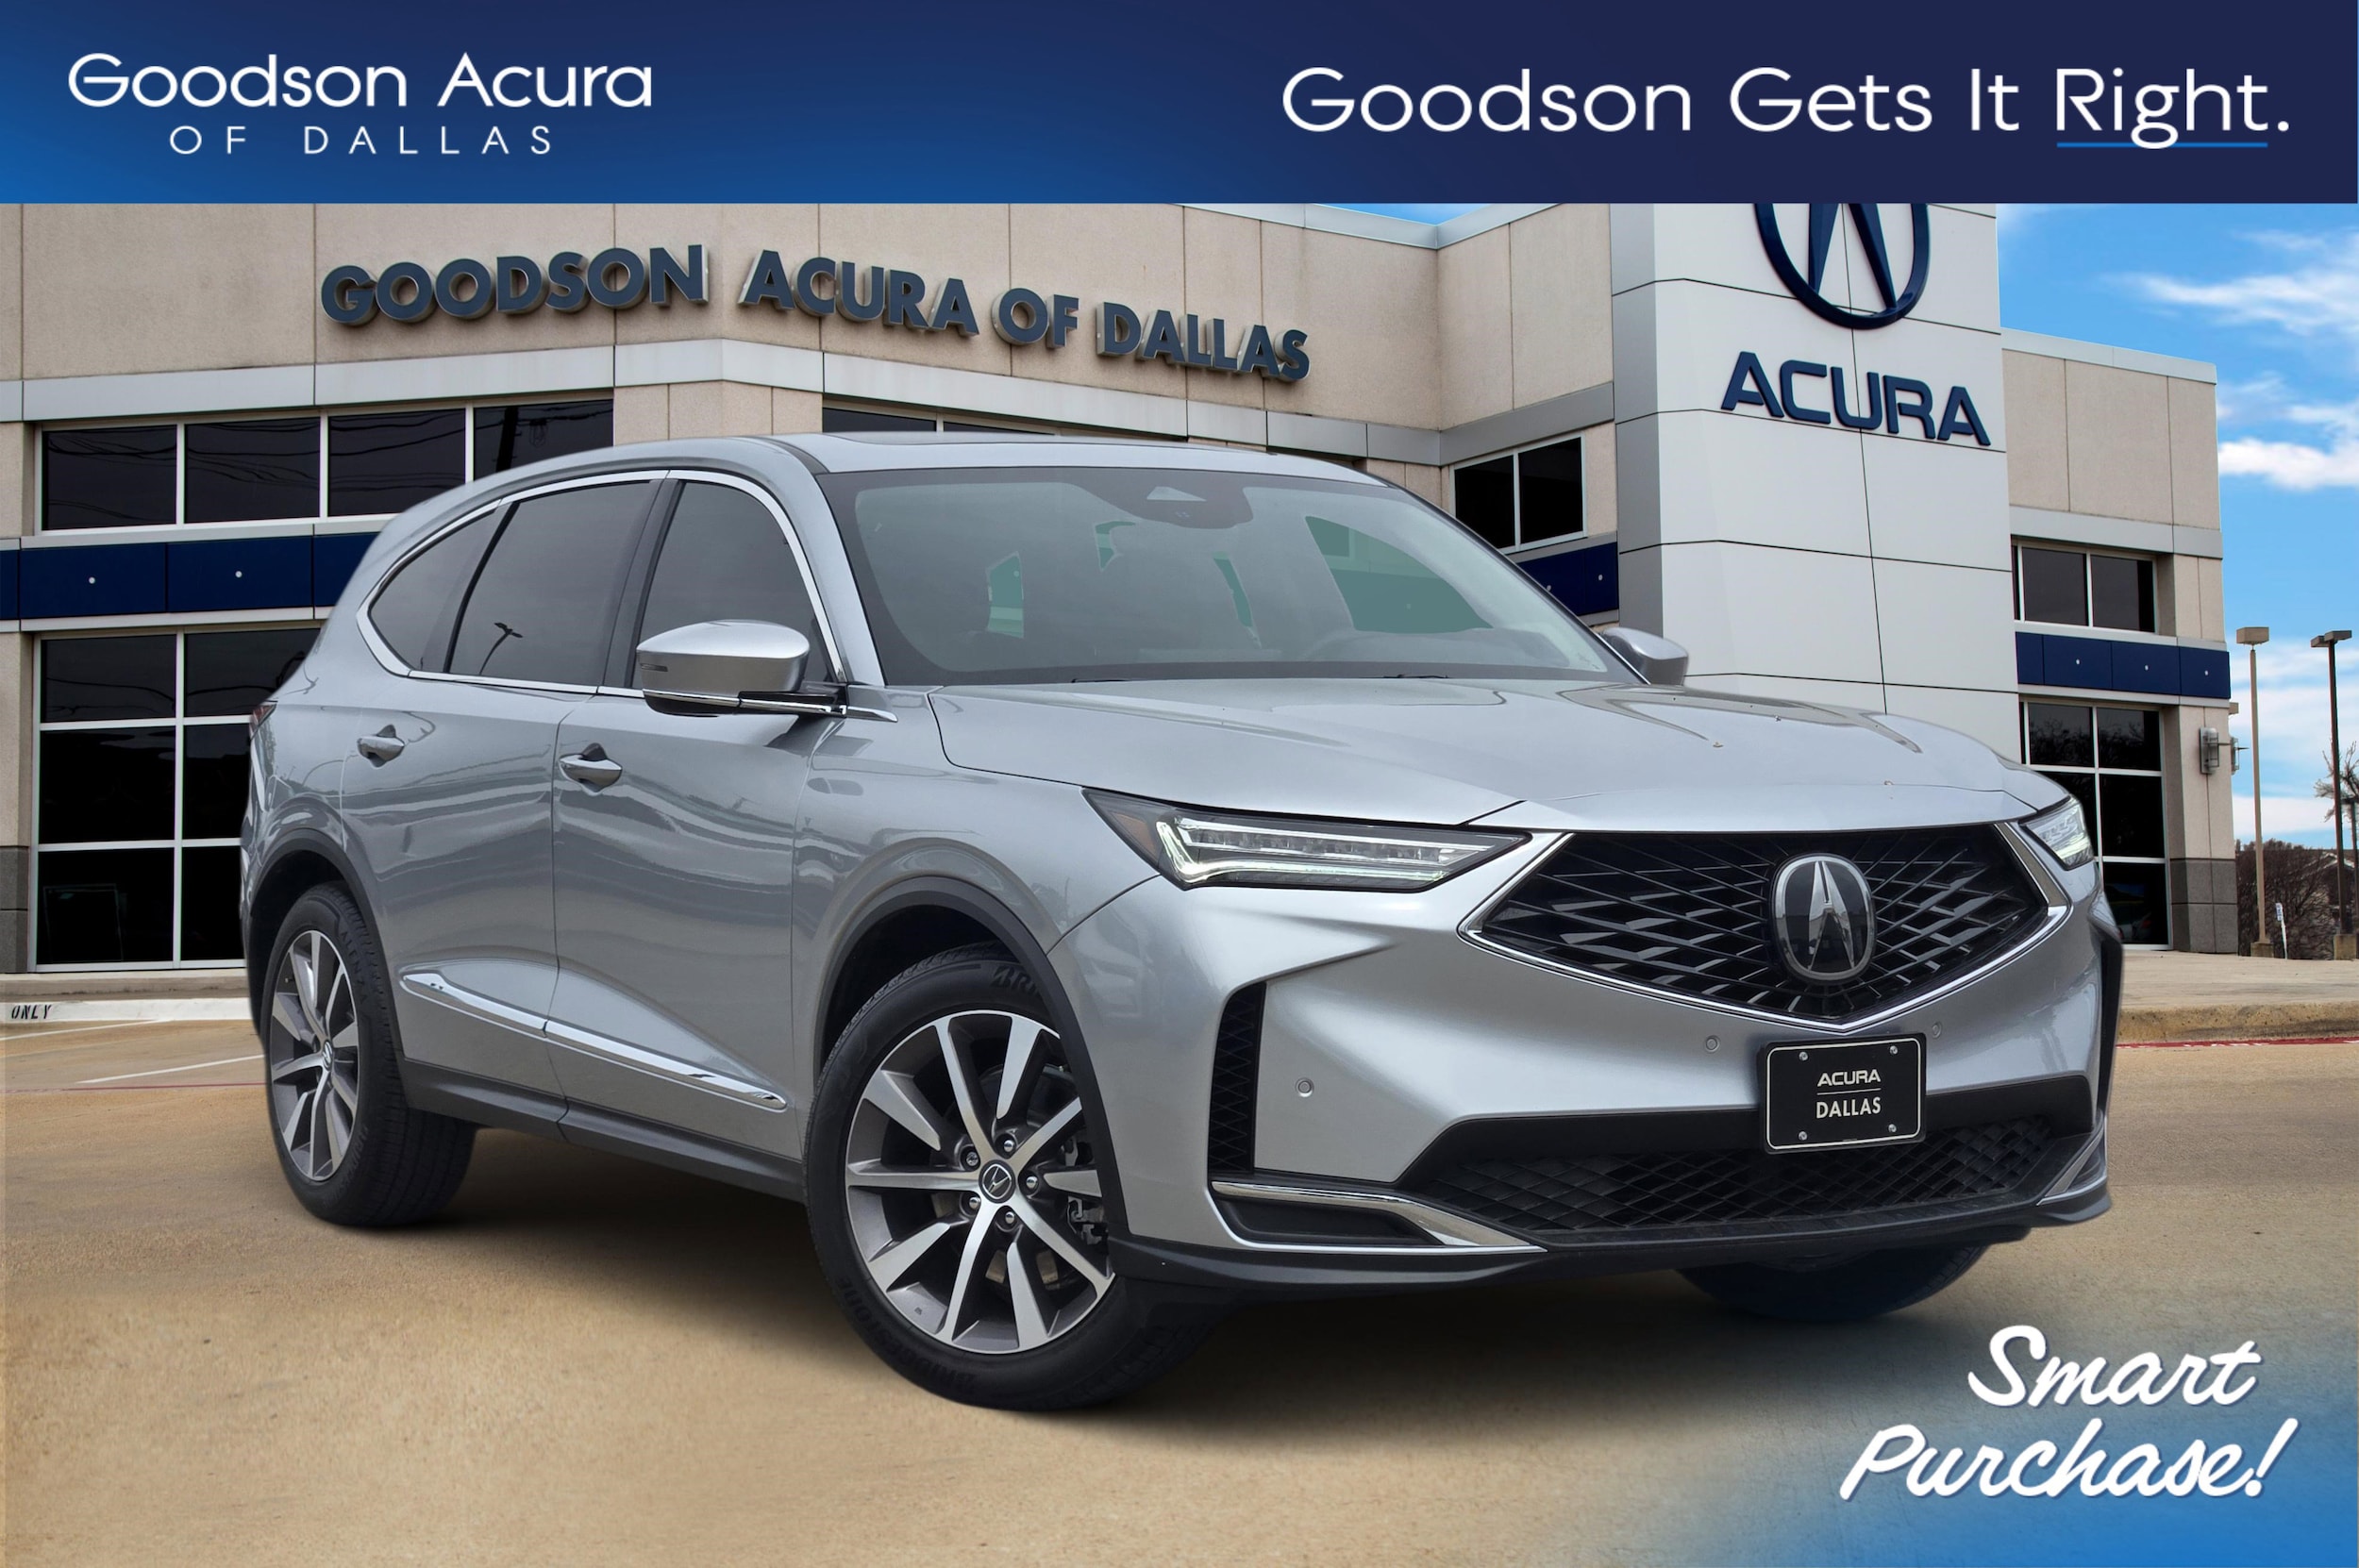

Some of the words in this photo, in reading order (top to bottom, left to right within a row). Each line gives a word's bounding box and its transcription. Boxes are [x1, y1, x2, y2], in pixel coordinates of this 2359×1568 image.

[321, 243, 709, 326] GOODSON
[738, 249, 979, 337] ACURA
[992, 287, 1079, 349] OF
[1096, 301, 1311, 382] DALLAS
[1721, 351, 1991, 446] ACURA
[11, 1004, 52, 1019] ONLY
[1816, 1068, 1882, 1087] ACURA
[1815, 1096, 1882, 1119] DALLAS
